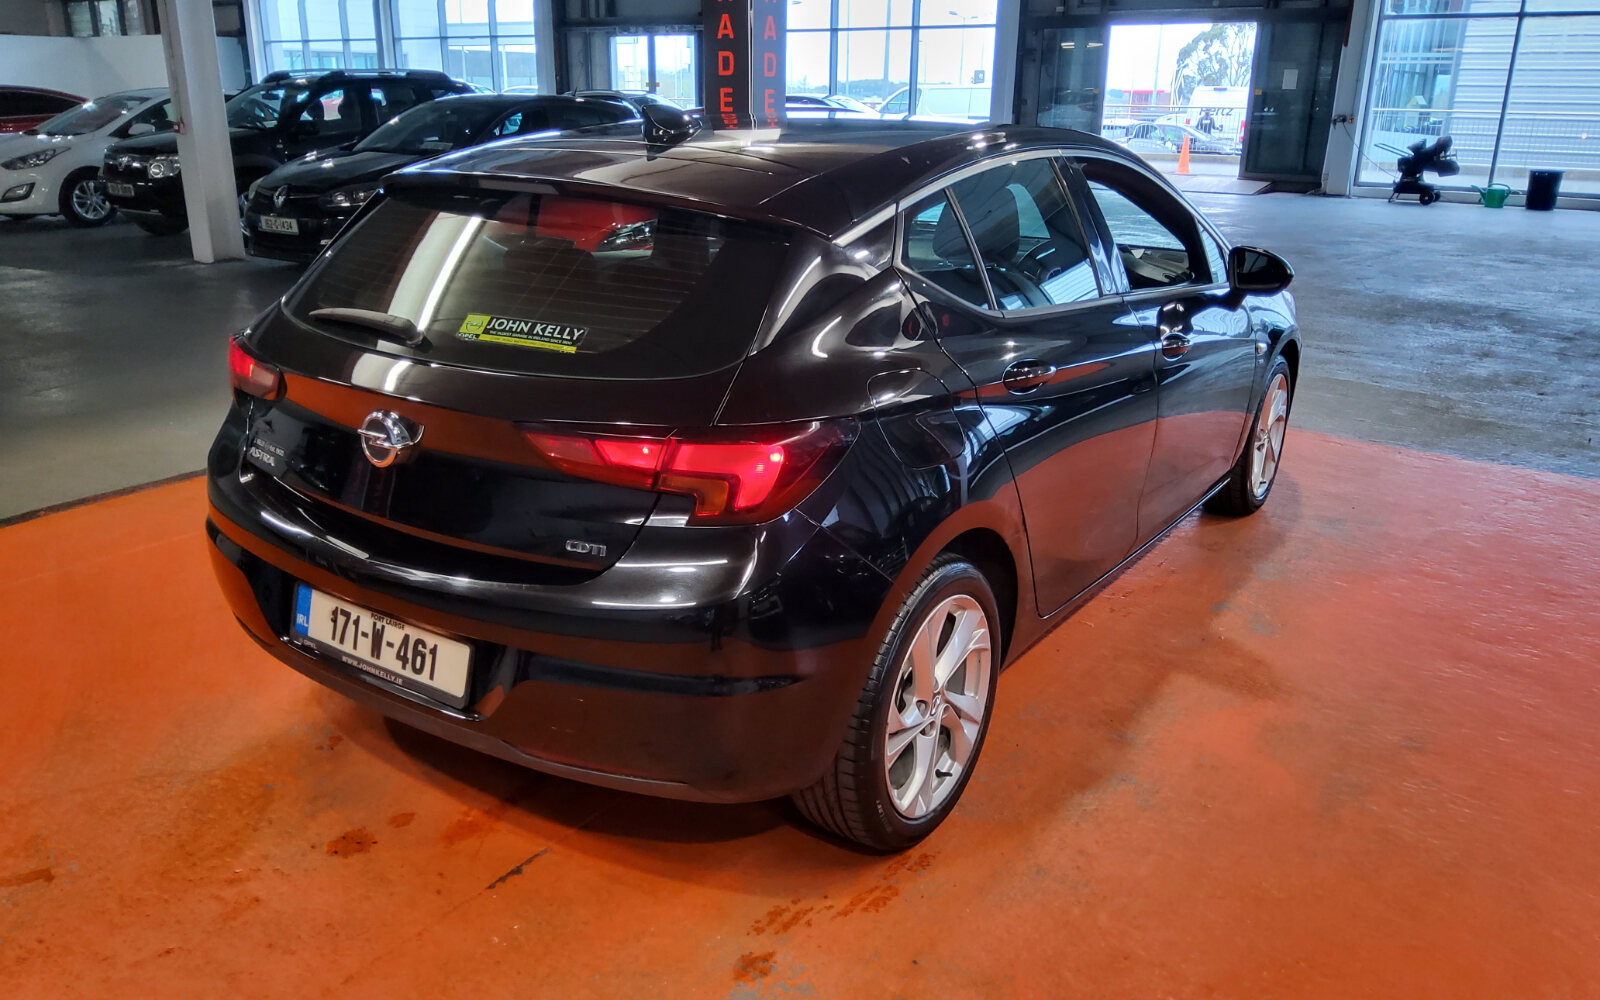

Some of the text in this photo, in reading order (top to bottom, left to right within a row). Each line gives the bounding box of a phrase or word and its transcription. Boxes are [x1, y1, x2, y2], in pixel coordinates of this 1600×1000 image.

[717, 0, 735, 113] ADE
[763, 0, 777, 114] ADE
[487, 318, 584, 341] JOHN KELLY
[249, 446, 275, 467] ASTRA
[565, 540, 607, 557] CDTI
[296, 612, 309, 628] IRL
[370, 612, 385, 625] PORT
[331, 606, 439, 682] 171-W-461
[341, 656, 403, 685] WWW.JOHNKELLY.IE
